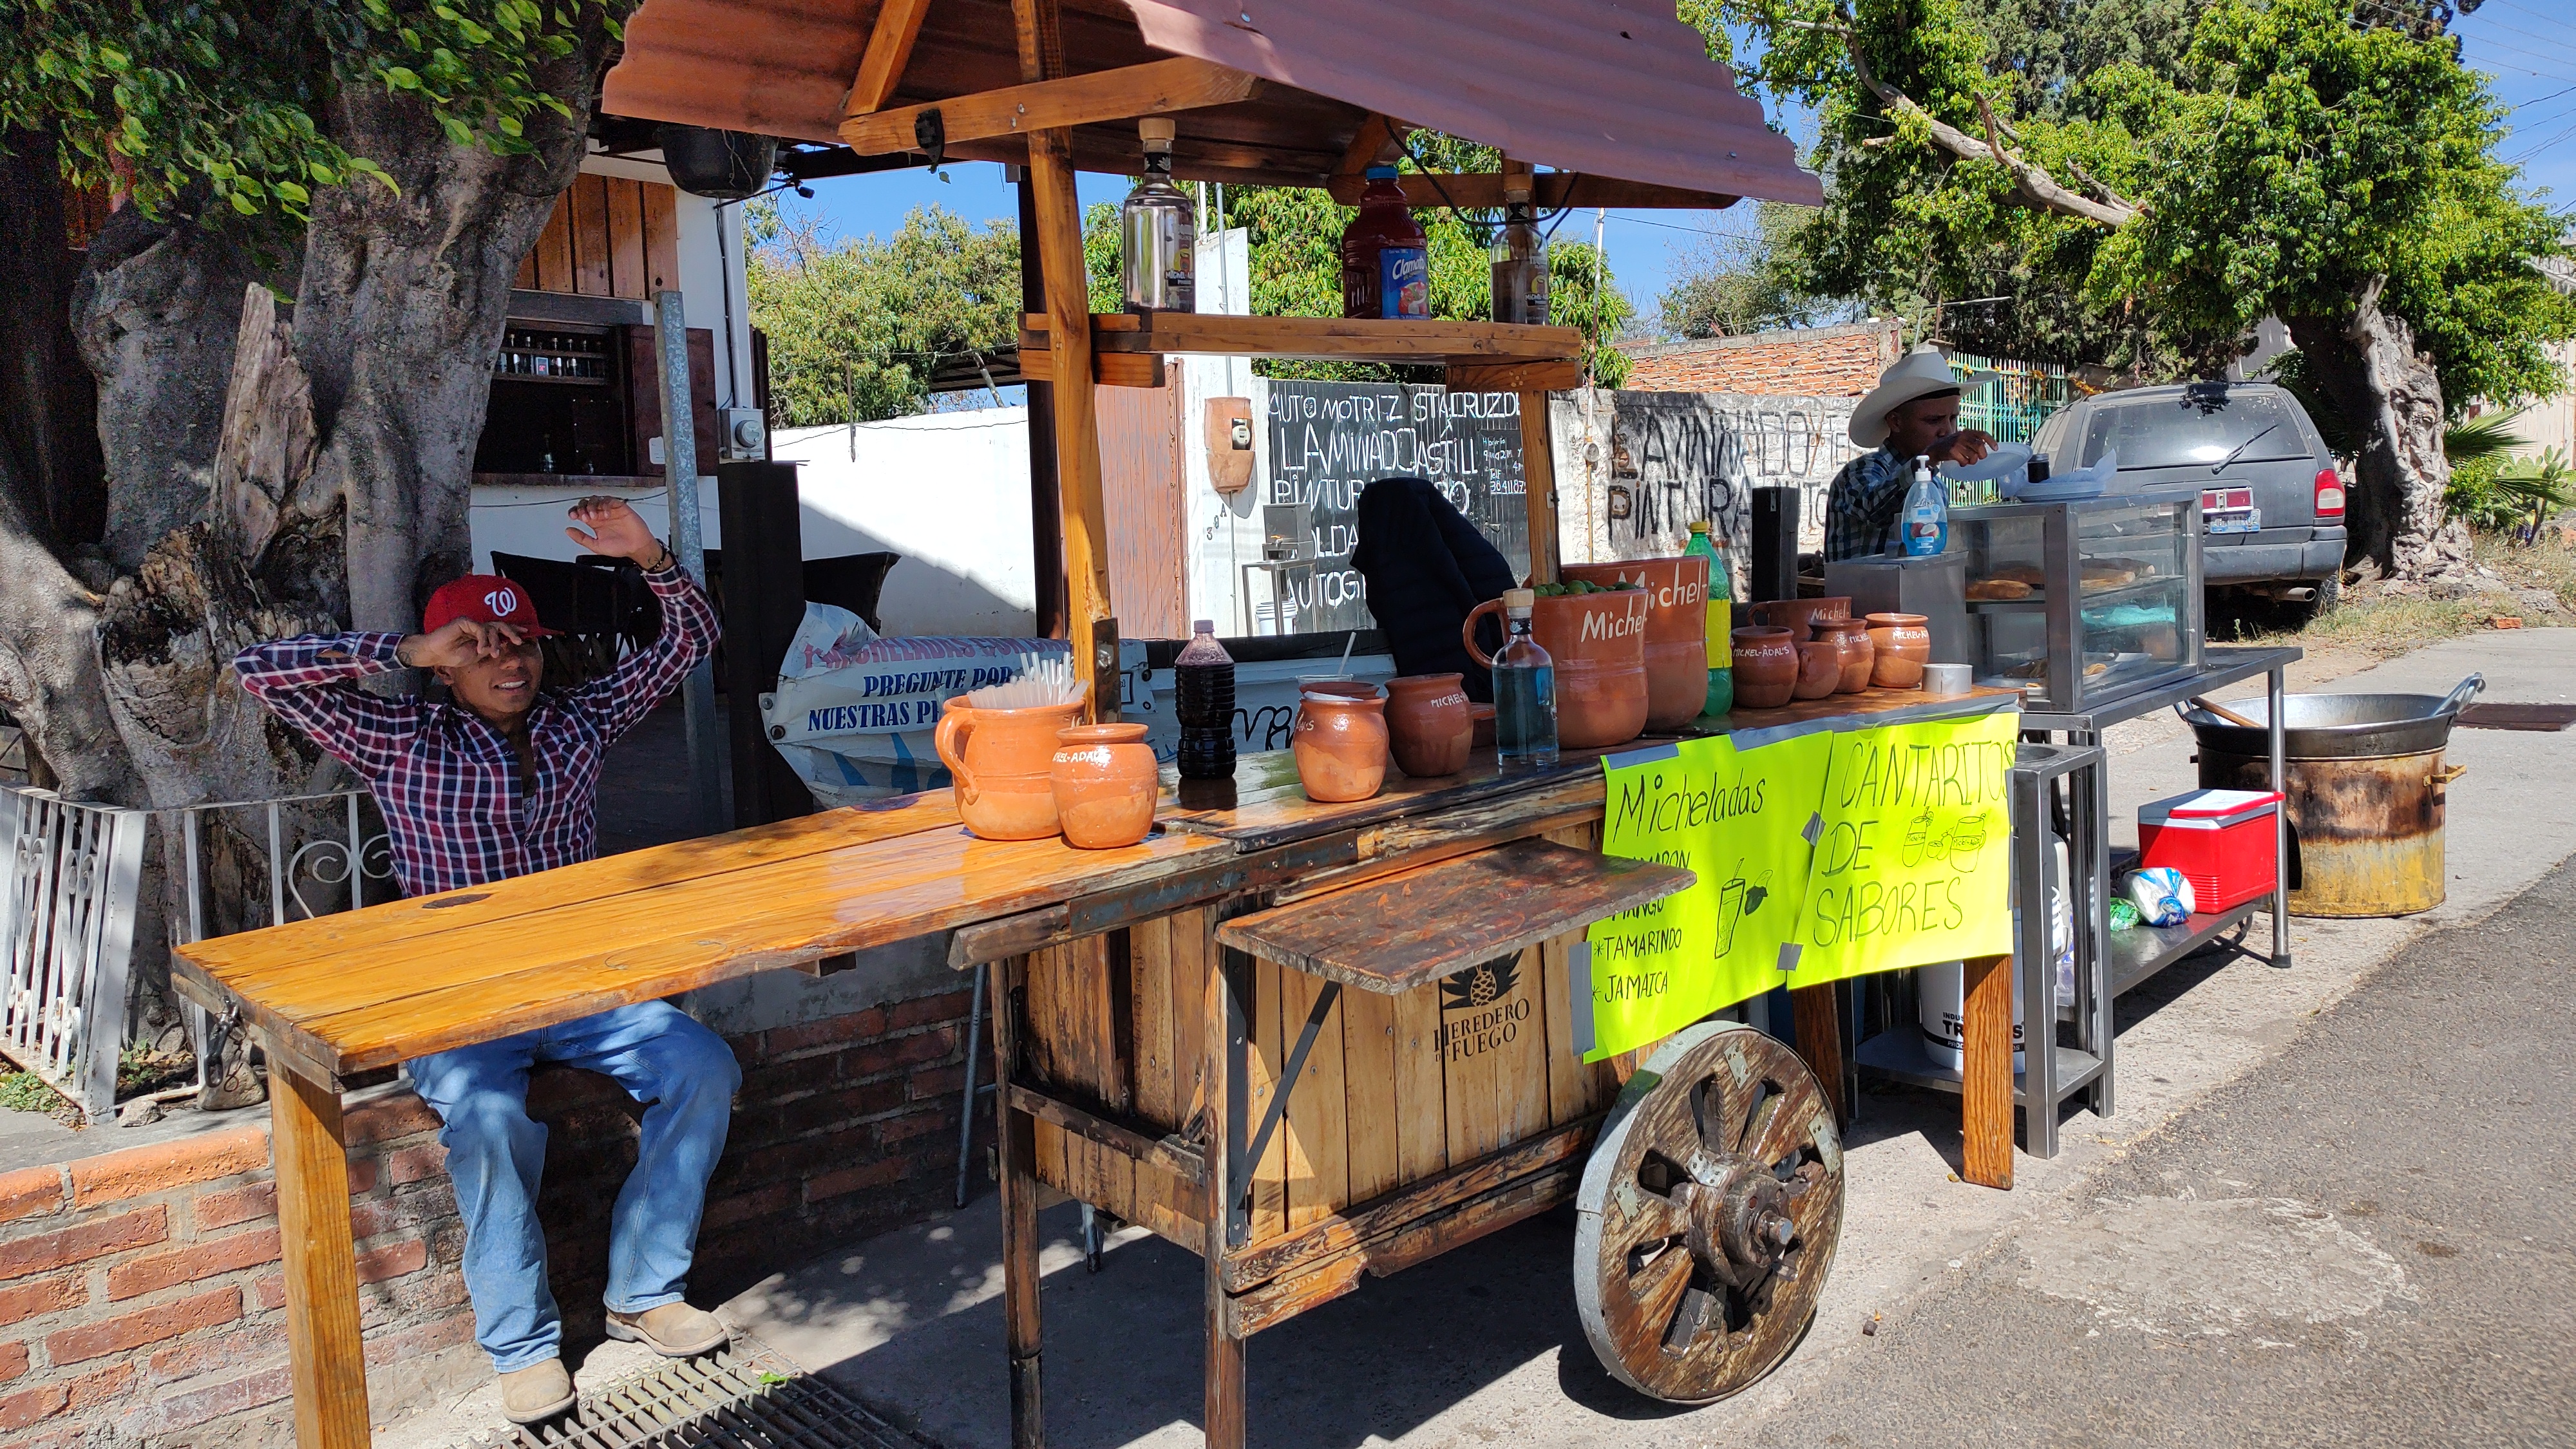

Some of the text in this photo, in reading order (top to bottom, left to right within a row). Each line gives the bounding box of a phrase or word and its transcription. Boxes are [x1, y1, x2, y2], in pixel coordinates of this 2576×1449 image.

[1392, 255, 1425, 280] Clamato
[484, 586, 518, 618] W
[862, 668, 967, 698] PREGUNTE
[808, 701, 910, 732] NUESTRAS
[1613, 767, 1766, 844] Micheladas
[1821, 820, 1879, 876] DE
[1814, 876, 1963, 947] SABORES
[1603, 927, 1681, 961] TAMARINDO
[1604, 970, 1668, 1003] JAMAICA
[1433, 998, 1530, 1053] HEREDERO
[1452, 1022, 1517, 1062] FUEGO
